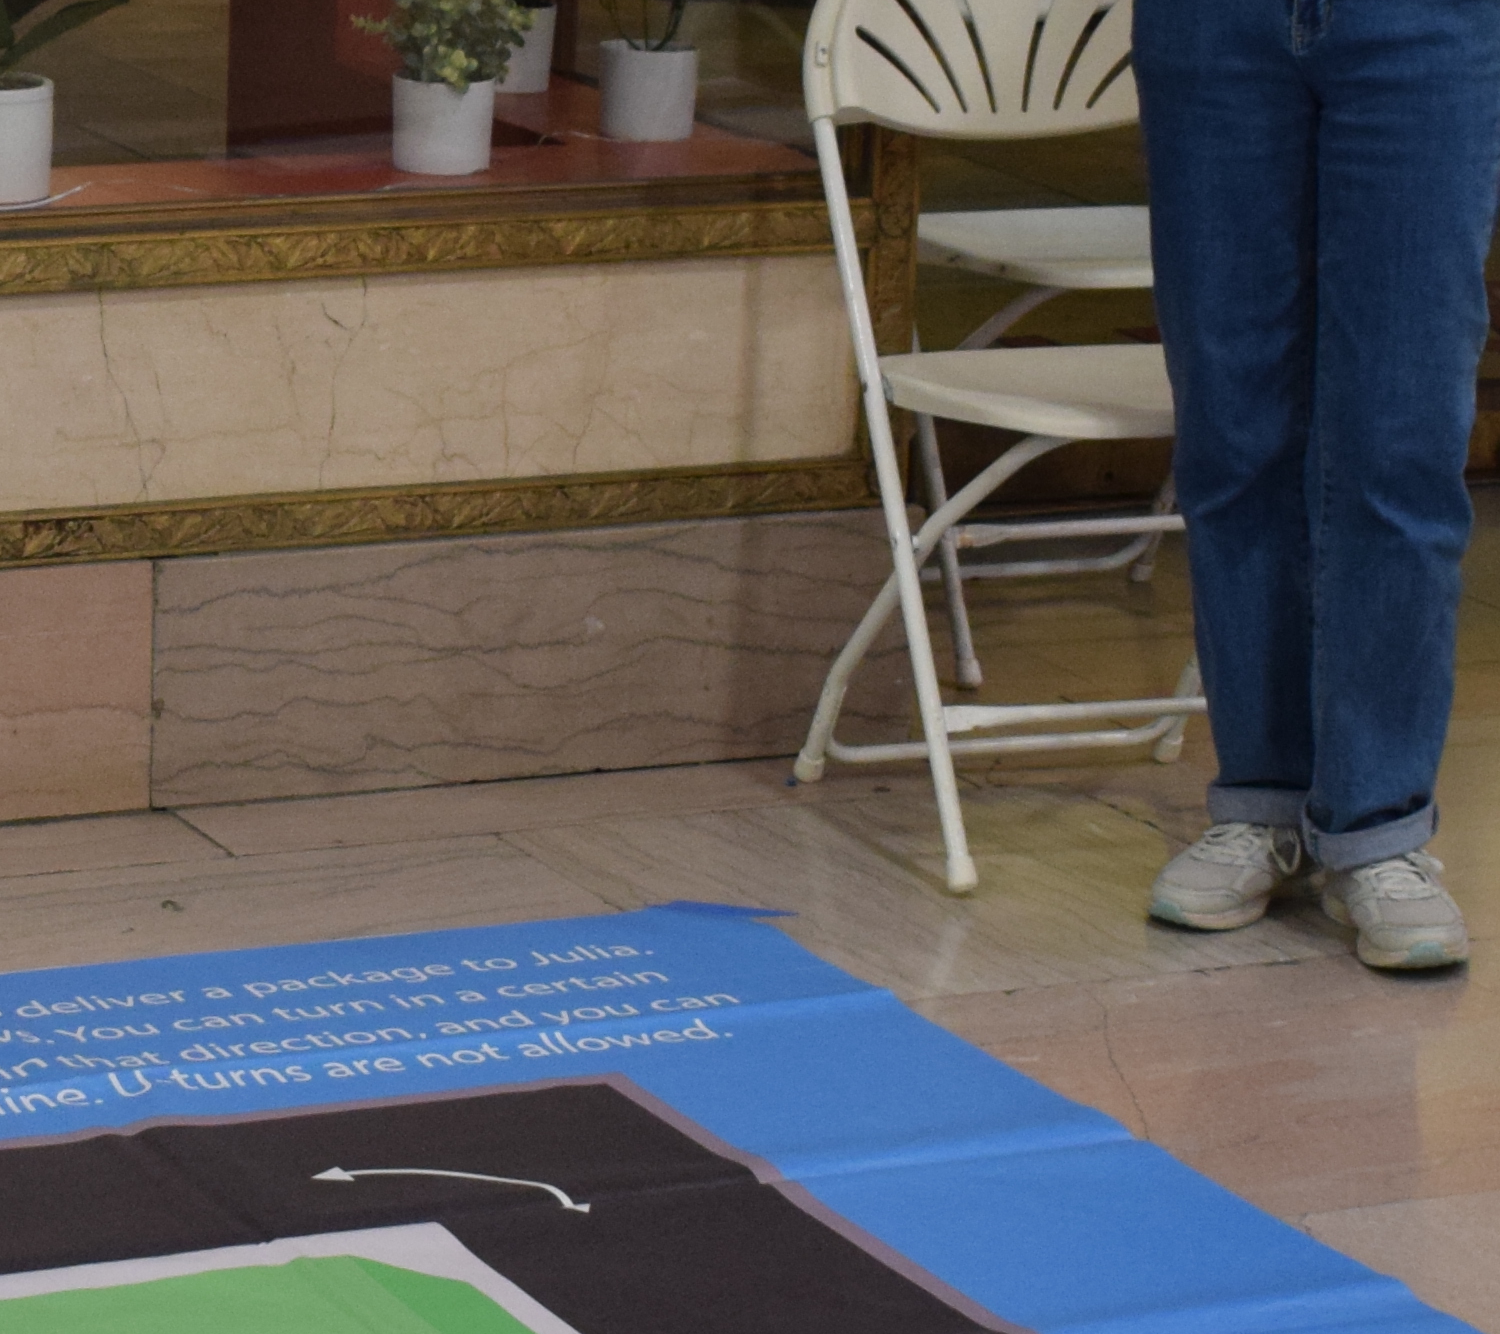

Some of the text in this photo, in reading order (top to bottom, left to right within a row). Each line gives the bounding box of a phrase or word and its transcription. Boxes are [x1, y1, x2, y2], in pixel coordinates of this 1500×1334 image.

[15, 988, 186, 1019] deliver
[202, 985, 232, 1000] a
[243, 962, 455, 999] package
[461, 957, 518, 973] to
[529, 943, 655, 967] Julia.
[55, 1022, 161, 1043] You
[172, 1009, 266, 1032] can
[272, 1000, 384, 1022] turn
[389, 992, 445, 1010] in
[455, 989, 486, 1003] a
[496, 969, 669, 998] certain
[55, 1049, 170, 1069] that
[180, 1024, 427, 1063] direction,
[434, 1009, 536, 1036] and
[540, 1001, 641, 1025] you
[651, 990, 740, 1012] can
[321, 1057, 406, 1079] are
[415, 1042, 510, 1068] not
[517, 1018, 734, 1059] allowed.
